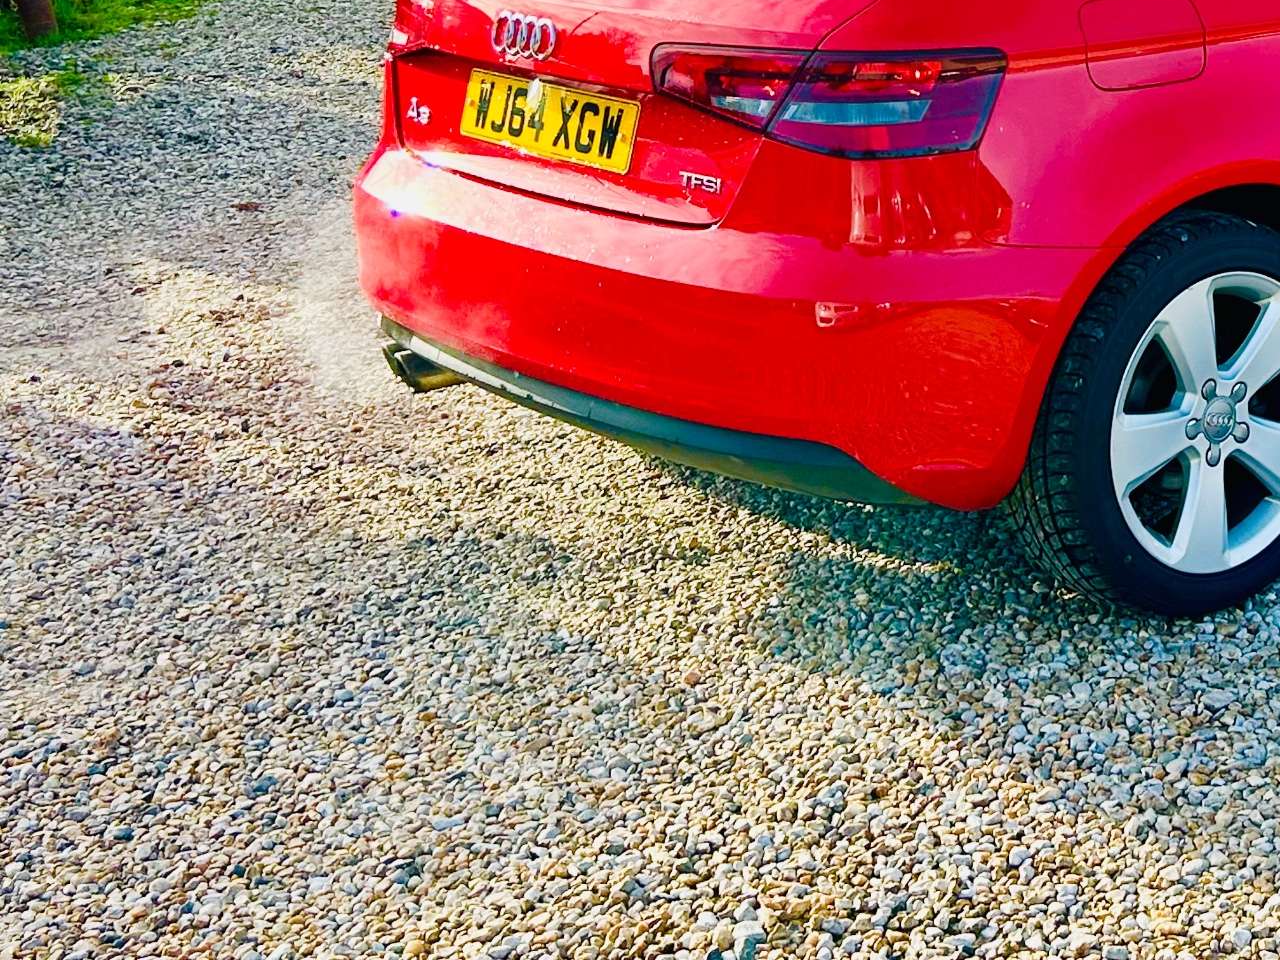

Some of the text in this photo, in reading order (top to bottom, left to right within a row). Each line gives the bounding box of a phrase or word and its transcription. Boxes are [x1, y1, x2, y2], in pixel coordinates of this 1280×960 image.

[406, 96, 431, 125] A3
[475, 78, 624, 160] WJ64 XGW
[678, 170, 721, 194] TFSI
